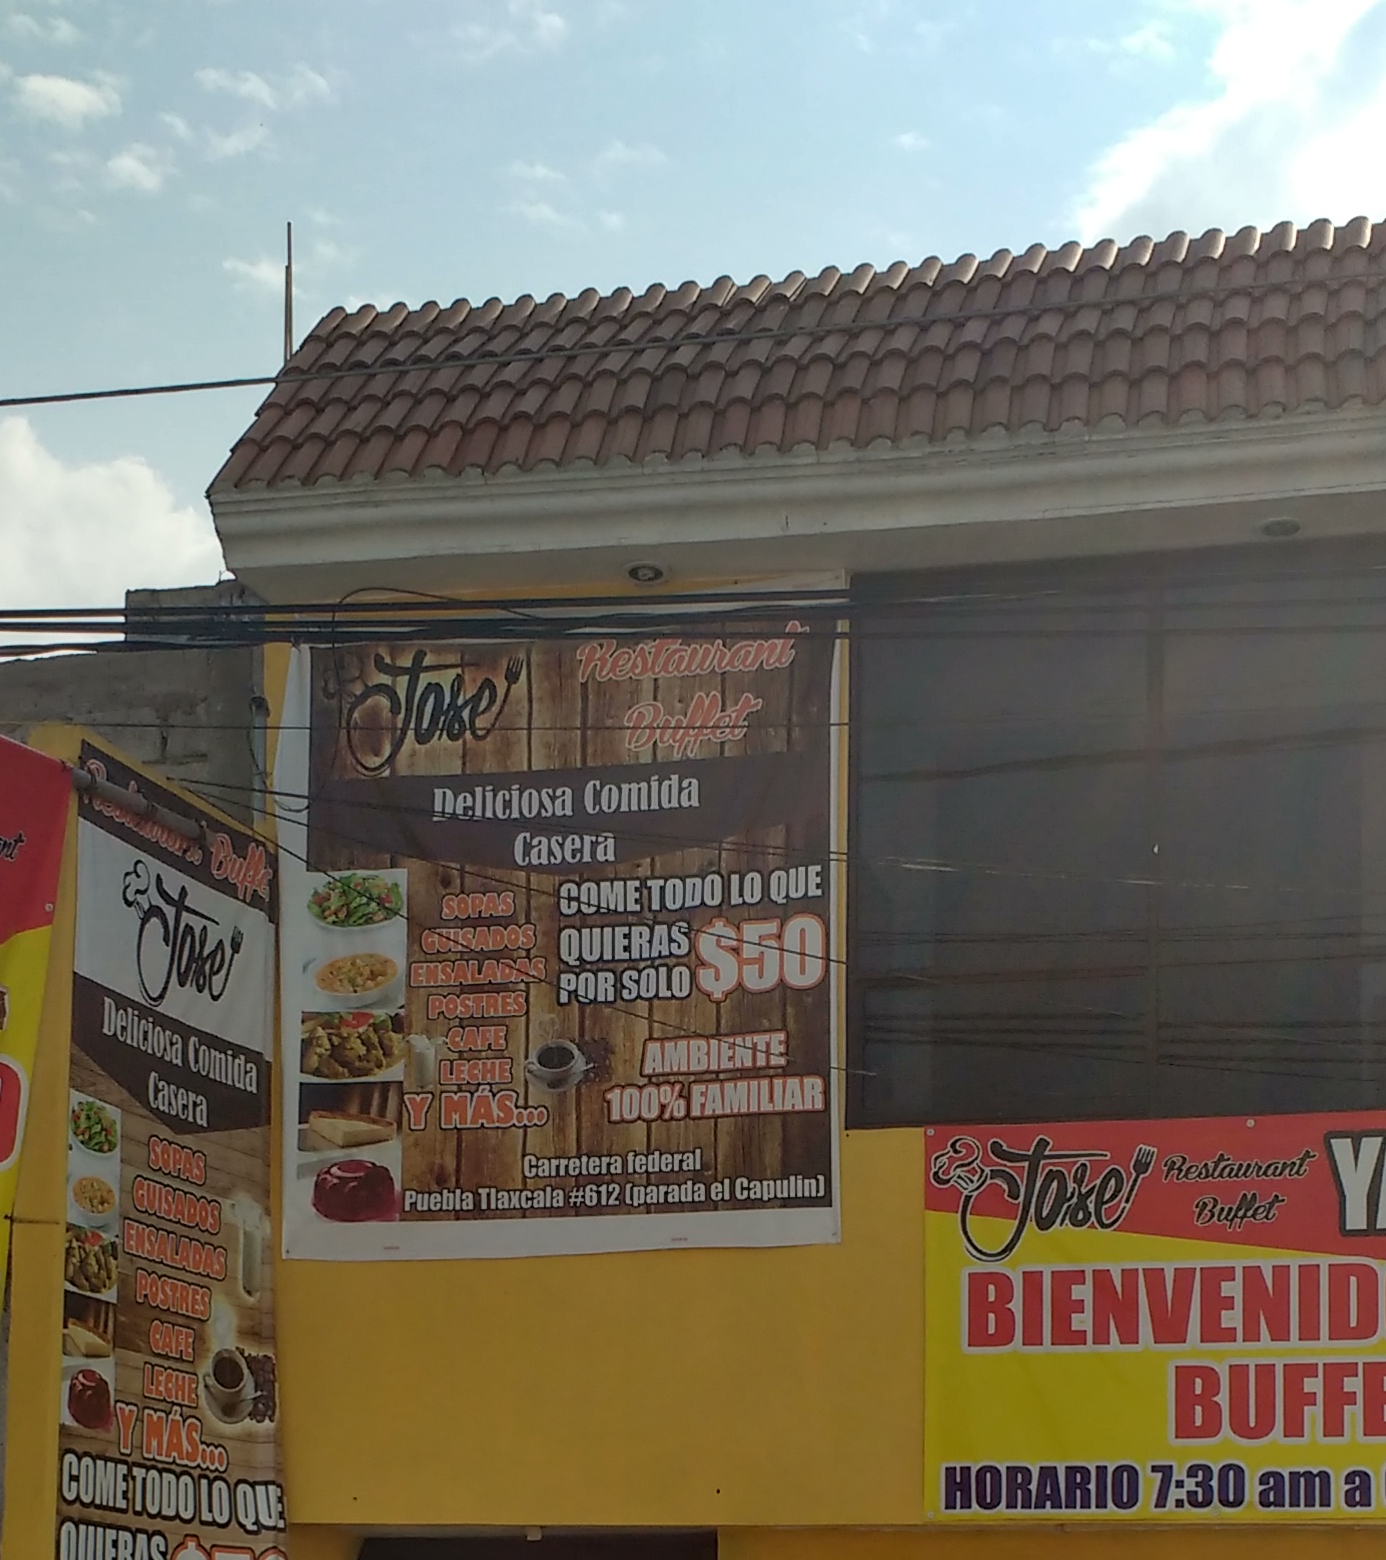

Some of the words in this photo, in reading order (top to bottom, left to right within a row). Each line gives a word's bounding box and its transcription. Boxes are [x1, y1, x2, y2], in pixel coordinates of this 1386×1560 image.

[577, 620, 809, 683] Restaurant
[625, 692, 762, 759] Buffet
[432, 786, 573, 822] Deliciosa
[584, 774, 700, 812] Comida
[211, 832, 273, 903] Buffe
[513, 830, 615, 867] Casera
[441, 891, 515, 920] SOPAS
[558, 876, 643, 915] COME
[646, 873, 723, 911] TODO
[730, 871, 763, 906] LO
[768, 864, 823, 904] QUE
[420, 924, 536, 954] GUISADOS
[559, 922, 690, 964] QUIERAS
[695, 912, 827, 1003] $50
[410, 957, 547, 988] ENSALADAS
[559, 969, 615, 1005] POR
[620, 964, 690, 1001] SOLO
[428, 991, 527, 1020] POSTRES
[103, 996, 182, 1068] Deliciosa
[187, 1035, 258, 1094] Comida
[447, 1025, 506, 1052] CAFE
[642, 1031, 788, 1077] AMBIENTE
[439, 1057, 513, 1085] LECHE
[148, 1070, 209, 1128] Casera
[403, 1093, 432, 1131] Y
[440, 1086, 548, 1130] MÁS...
[606, 1084, 687, 1124] 100%
[689, 1076, 825, 1119] FAMILIAR
[148, 1136, 206, 1186] SOPAS
[523, 1153, 623, 1178] Carretera
[627, 1148, 702, 1173] federal
[1161, 1148, 1317, 1186] Restaurant
[132, 1177, 221, 1234] GUISADOS
[404, 1188, 475, 1213] Puebla
[478, 1186, 565, 1210] Tlaxcala
[568, 1183, 621, 1208] #612
[624, 1183, 706, 1208] (parada
[710, 1180, 730, 1201] el
[1193, 1192, 1286, 1229] Buffet
[123, 1219, 227, 1280] ENSALADAS
[135, 1270, 211, 1322] POSTRES
[149, 1319, 195, 1362] CAFE
[143, 1364, 198, 1406] LECHE
[115, 1401, 136, 1456] Y
[142, 1405, 228, 1474] MÁS...
[62, 1452, 128, 1511] COME
[131, 1467, 195, 1521] TODO
[199, 1477, 231, 1528] LO
[235, 1481, 286, 1531] QUE
[942, 1464, 1140, 1511] HORARIO
[1149, 1461, 1247, 1510] 7:30
[1256, 1469, 1334, 1509] am
[1340, 1471, 1375, 1509] a
